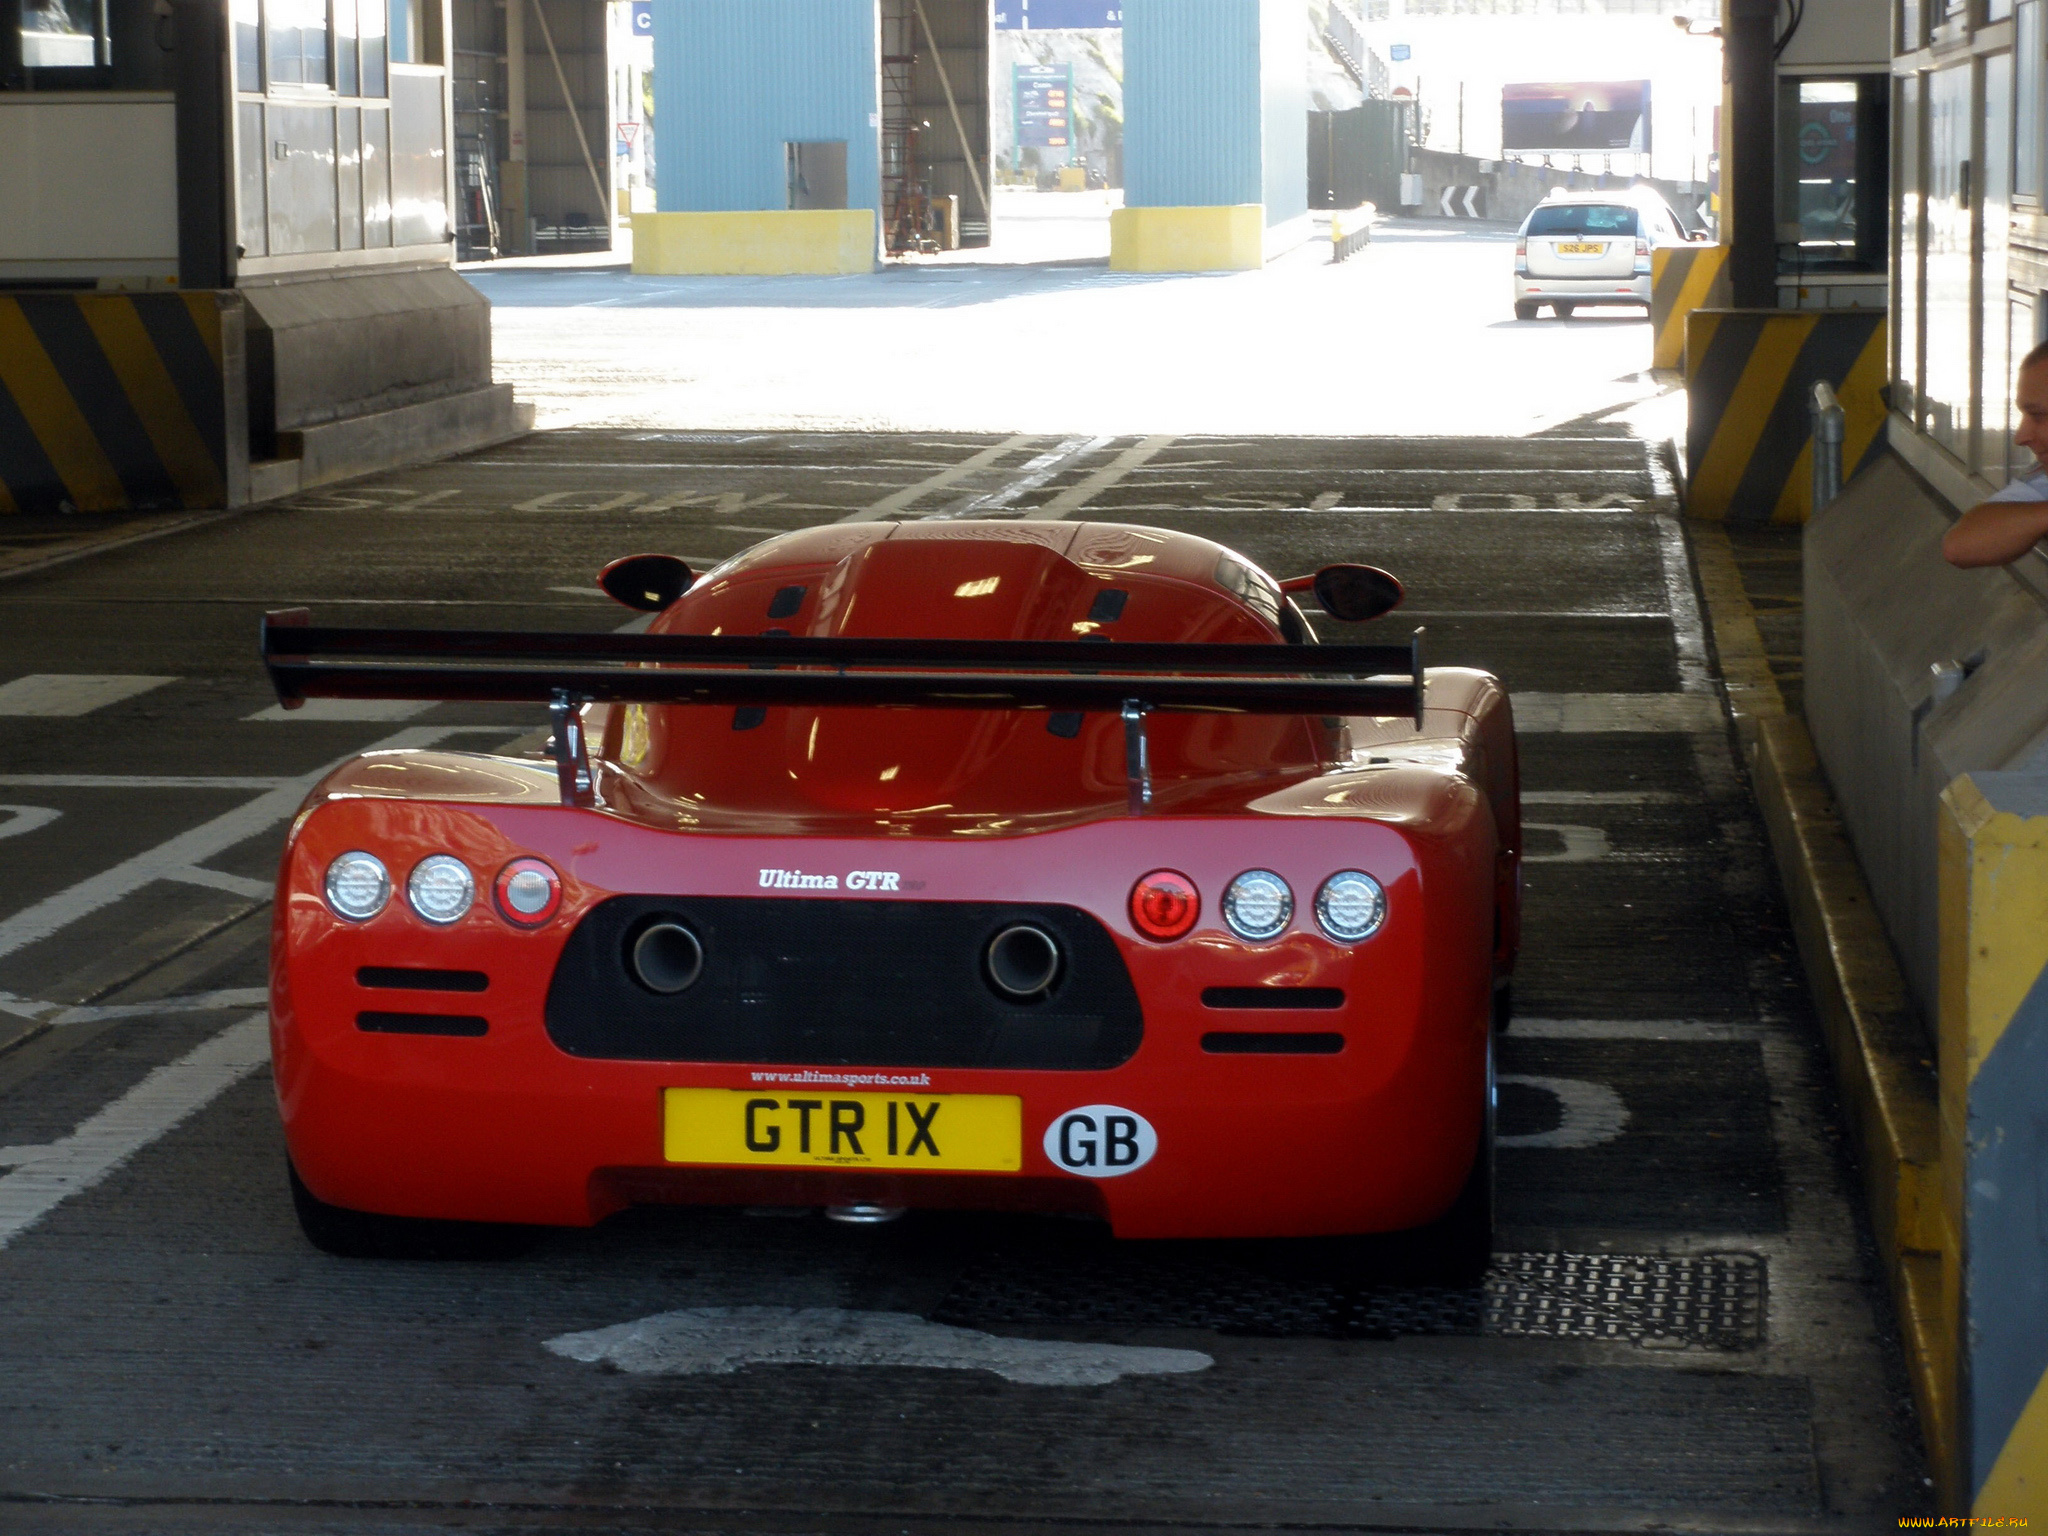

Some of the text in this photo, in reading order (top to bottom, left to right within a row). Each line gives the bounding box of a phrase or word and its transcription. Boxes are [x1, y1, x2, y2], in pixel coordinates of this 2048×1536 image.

[759, 869, 839, 889] Ultima
[845, 871, 901, 891] GTR
[751, 1070, 931, 1087] www.ultimasports.co.uk
[745, 1098, 865, 1155] GTR
[1059, 1114, 1139, 1167] GB
